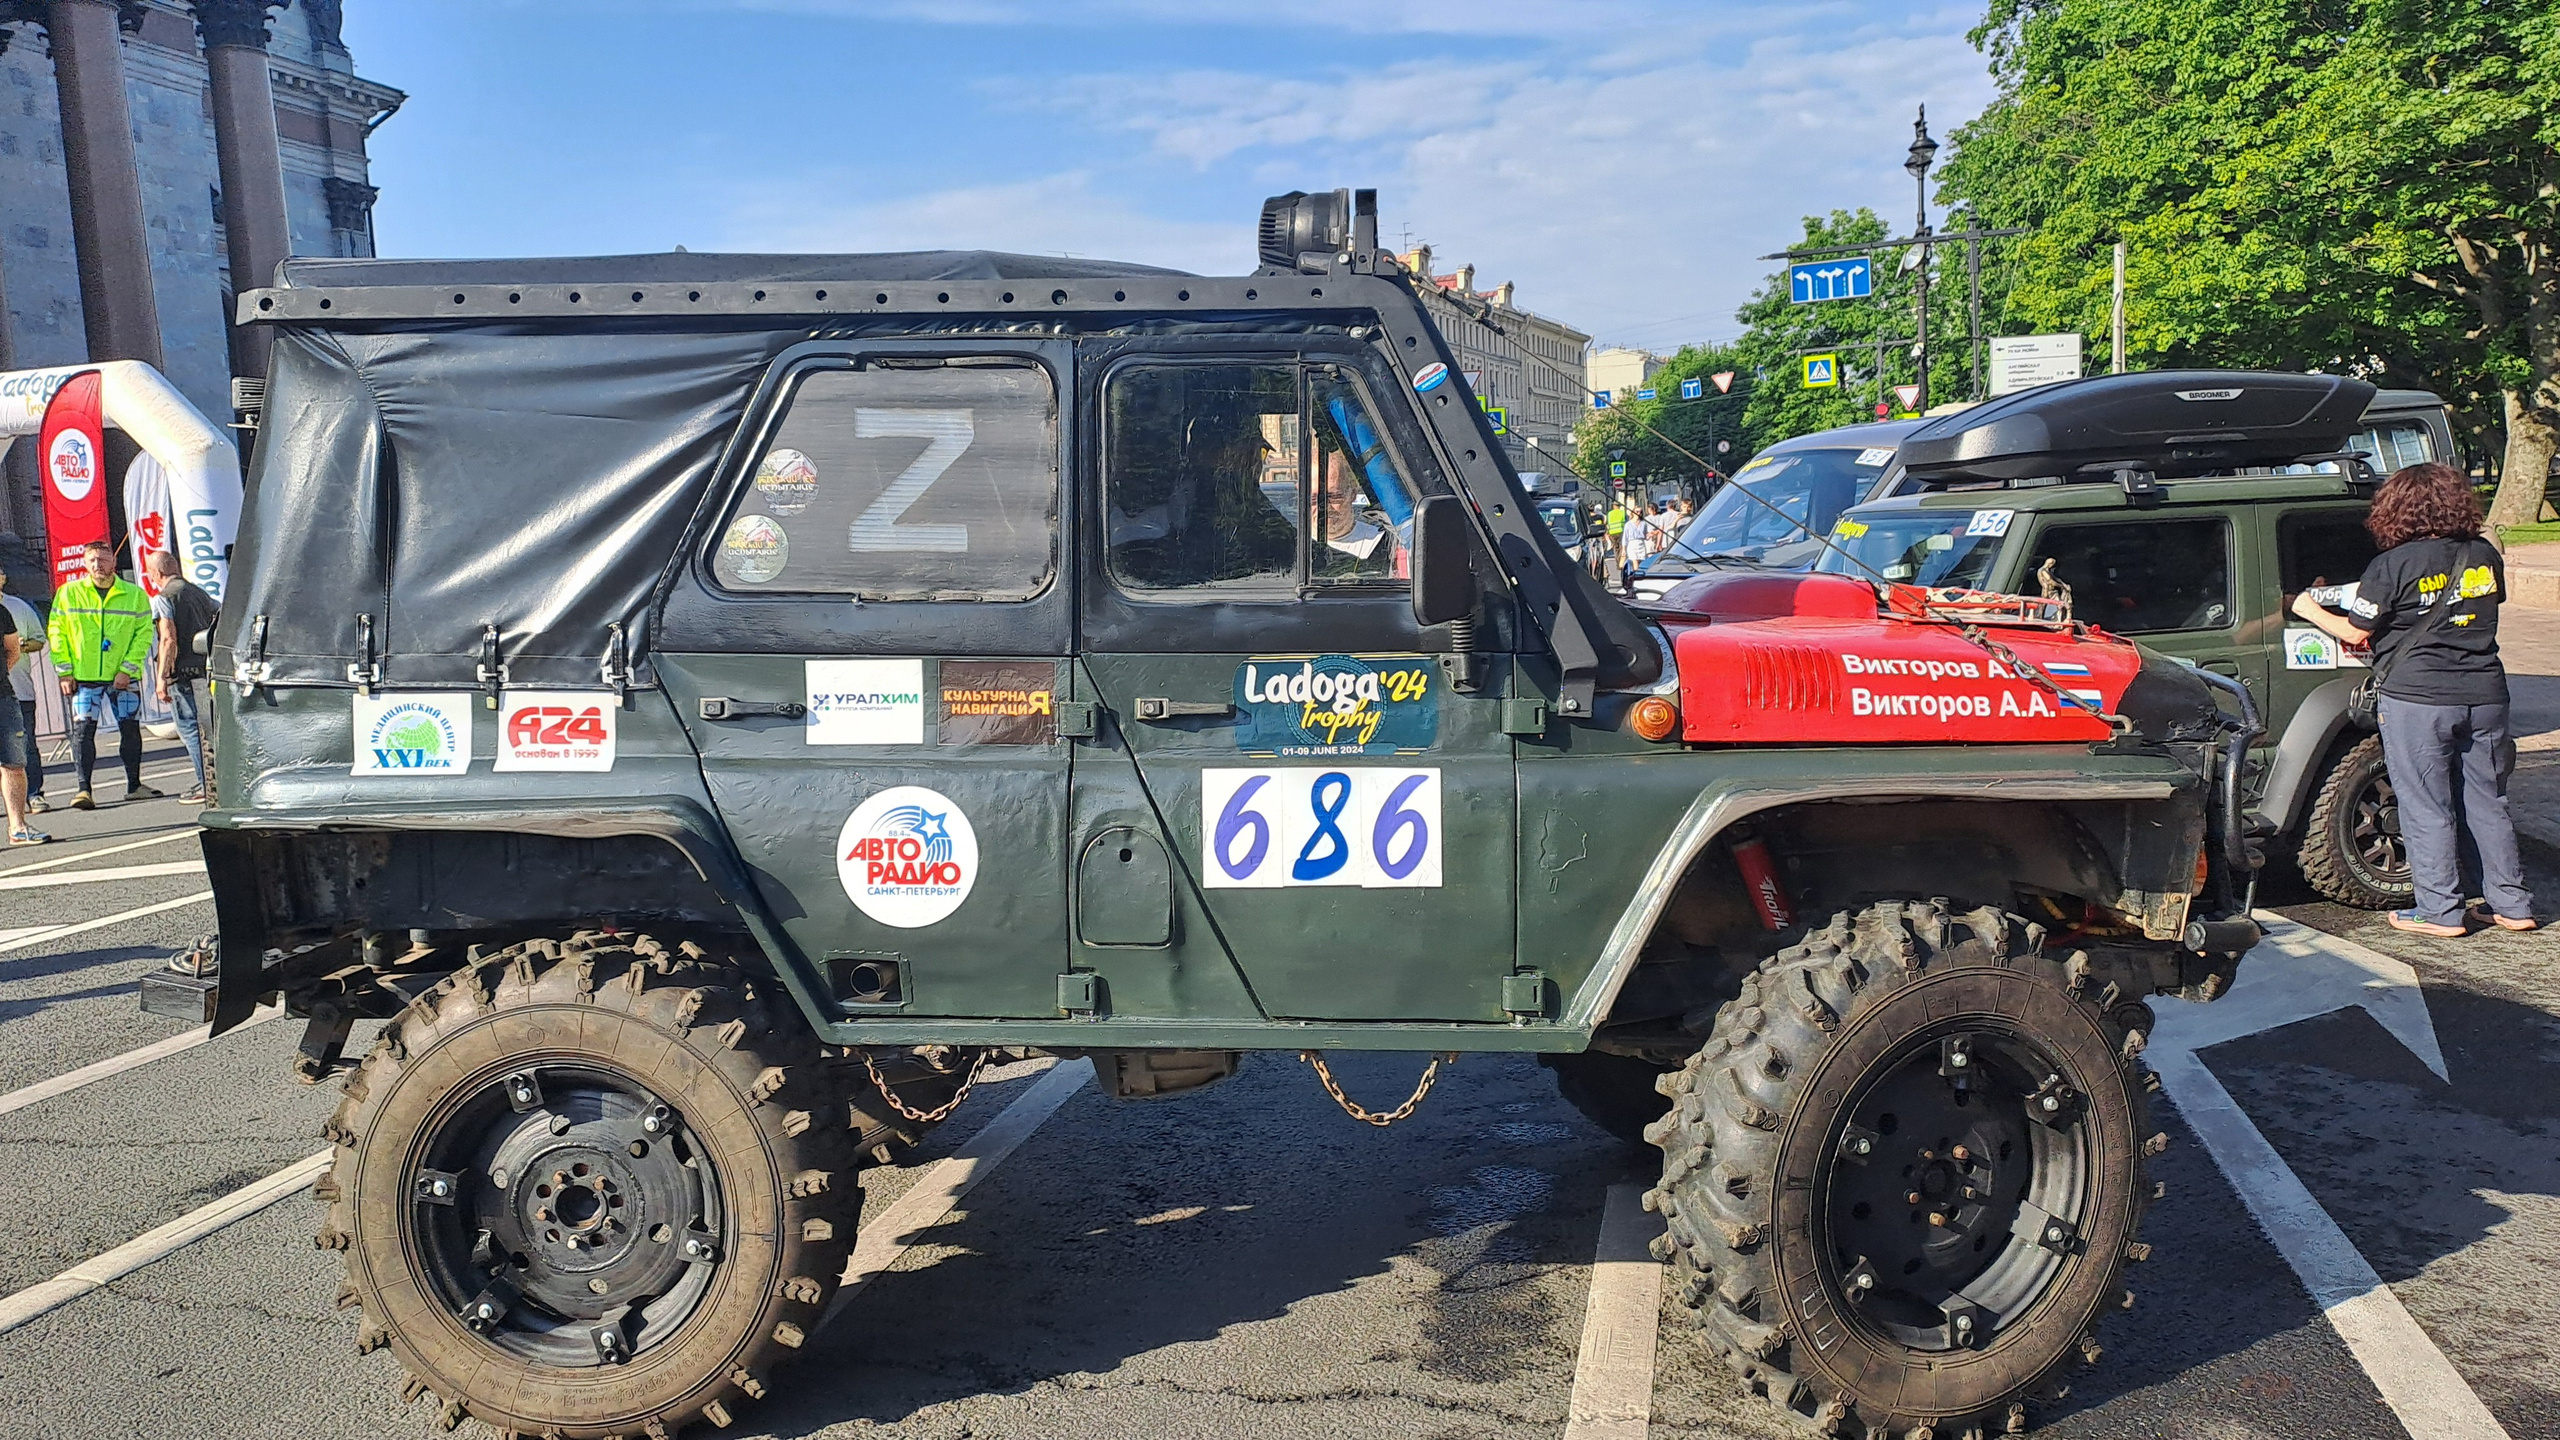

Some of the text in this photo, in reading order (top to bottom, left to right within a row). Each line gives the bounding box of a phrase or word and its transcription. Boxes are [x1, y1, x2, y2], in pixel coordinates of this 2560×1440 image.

[848, 407, 975, 553] Z
[1969, 512, 2010, 533] 856
[1841, 654, 1980, 681] Викторов
[2295, 654, 2317, 665] XXI
[834, 693, 918, 704] УРАЛХИМ
[1852, 688, 2056, 722] Викторов А.А.
[370, 702, 441, 744] МЕДИЦИНСКИЙ
[439, 717, 456, 752] ЦЕНТР
[370, 749, 424, 768] XXI
[515, 750, 560, 759] основан
[573, 749, 599, 758] 1999
[1282, 745, 1364, 756] 01-09 JUNE 2024
[424, 758, 453, 768] ВЕК
[1214, 771, 1430, 881] 686
[845, 838, 921, 861] АВТО
[867, 862, 961, 885] РАДИО
[867, 887, 961, 896] САНКТ-ПЕТЕРБУРГ
